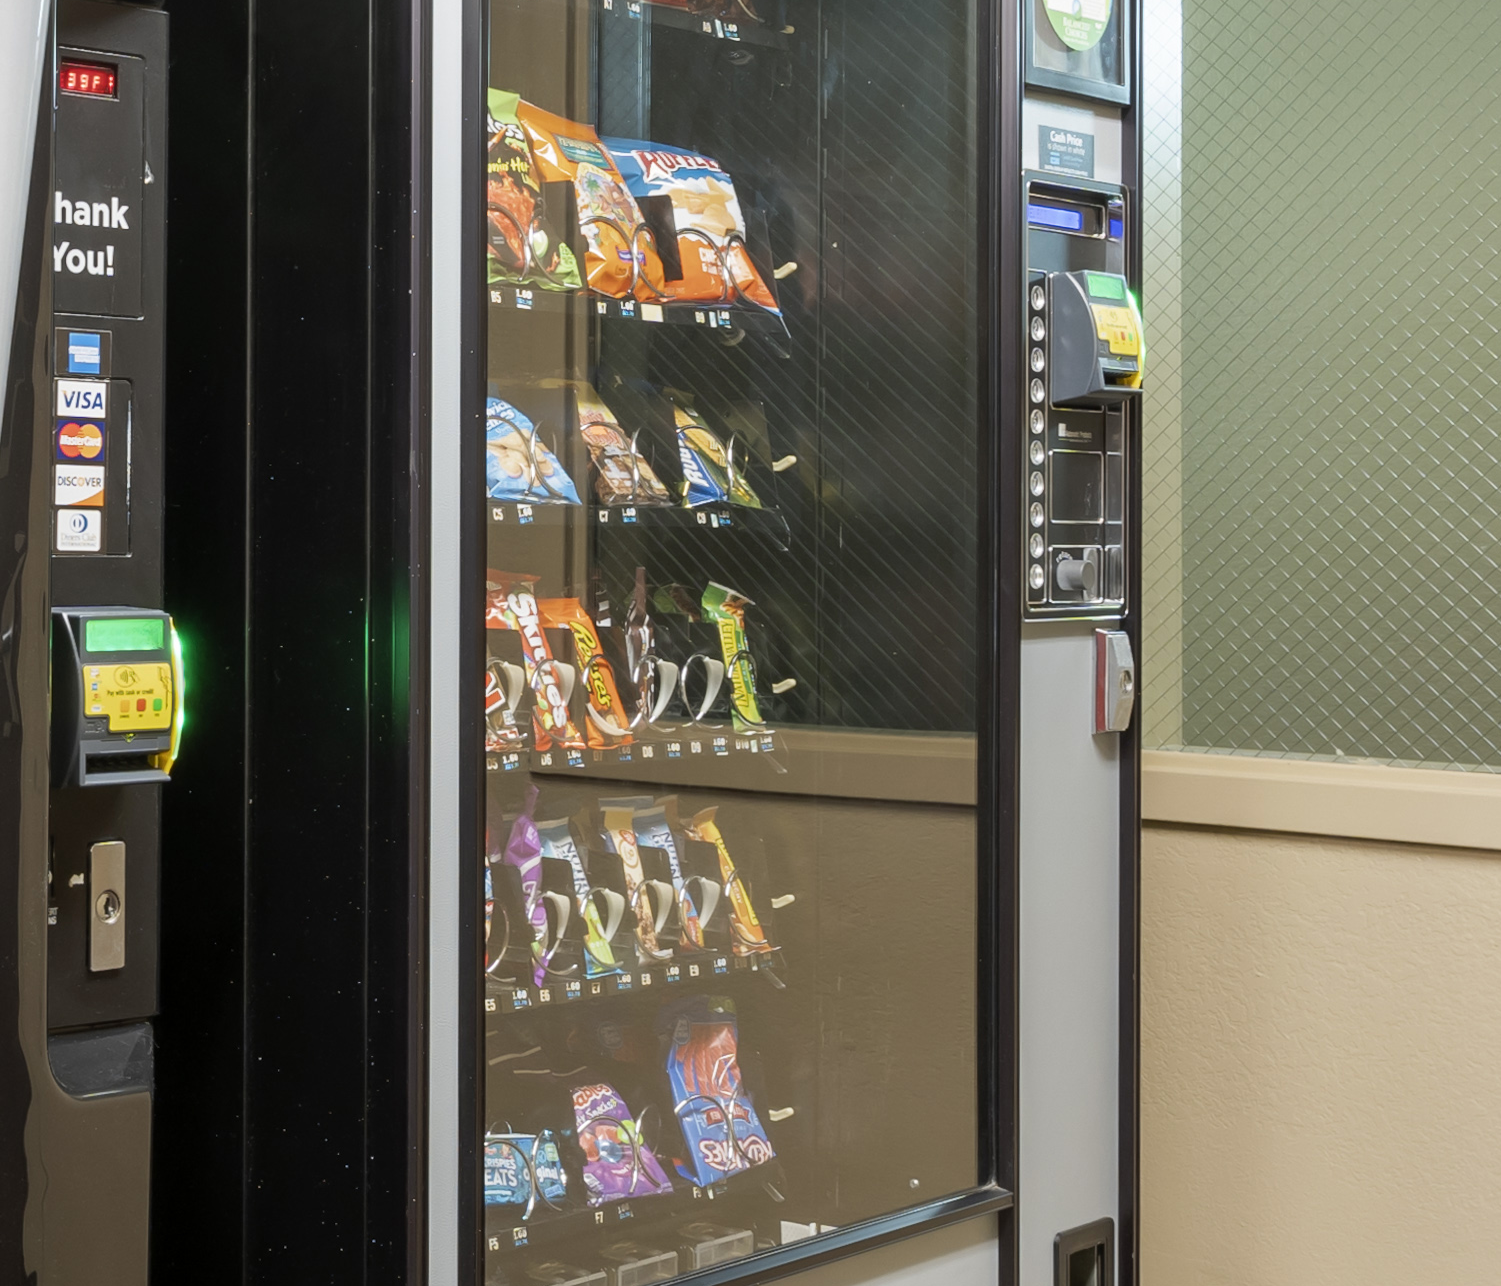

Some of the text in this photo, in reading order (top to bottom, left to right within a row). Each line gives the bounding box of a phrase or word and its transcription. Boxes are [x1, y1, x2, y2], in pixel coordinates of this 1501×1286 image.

[634, 150, 724, 178] RUFFLE
[55, 191, 130, 230] hank
[53, 241, 115, 277] You!
[63, 390, 104, 411] VISA
[60, 433, 101, 448] MasterCard
[57, 475, 102, 488] DISCOVER
